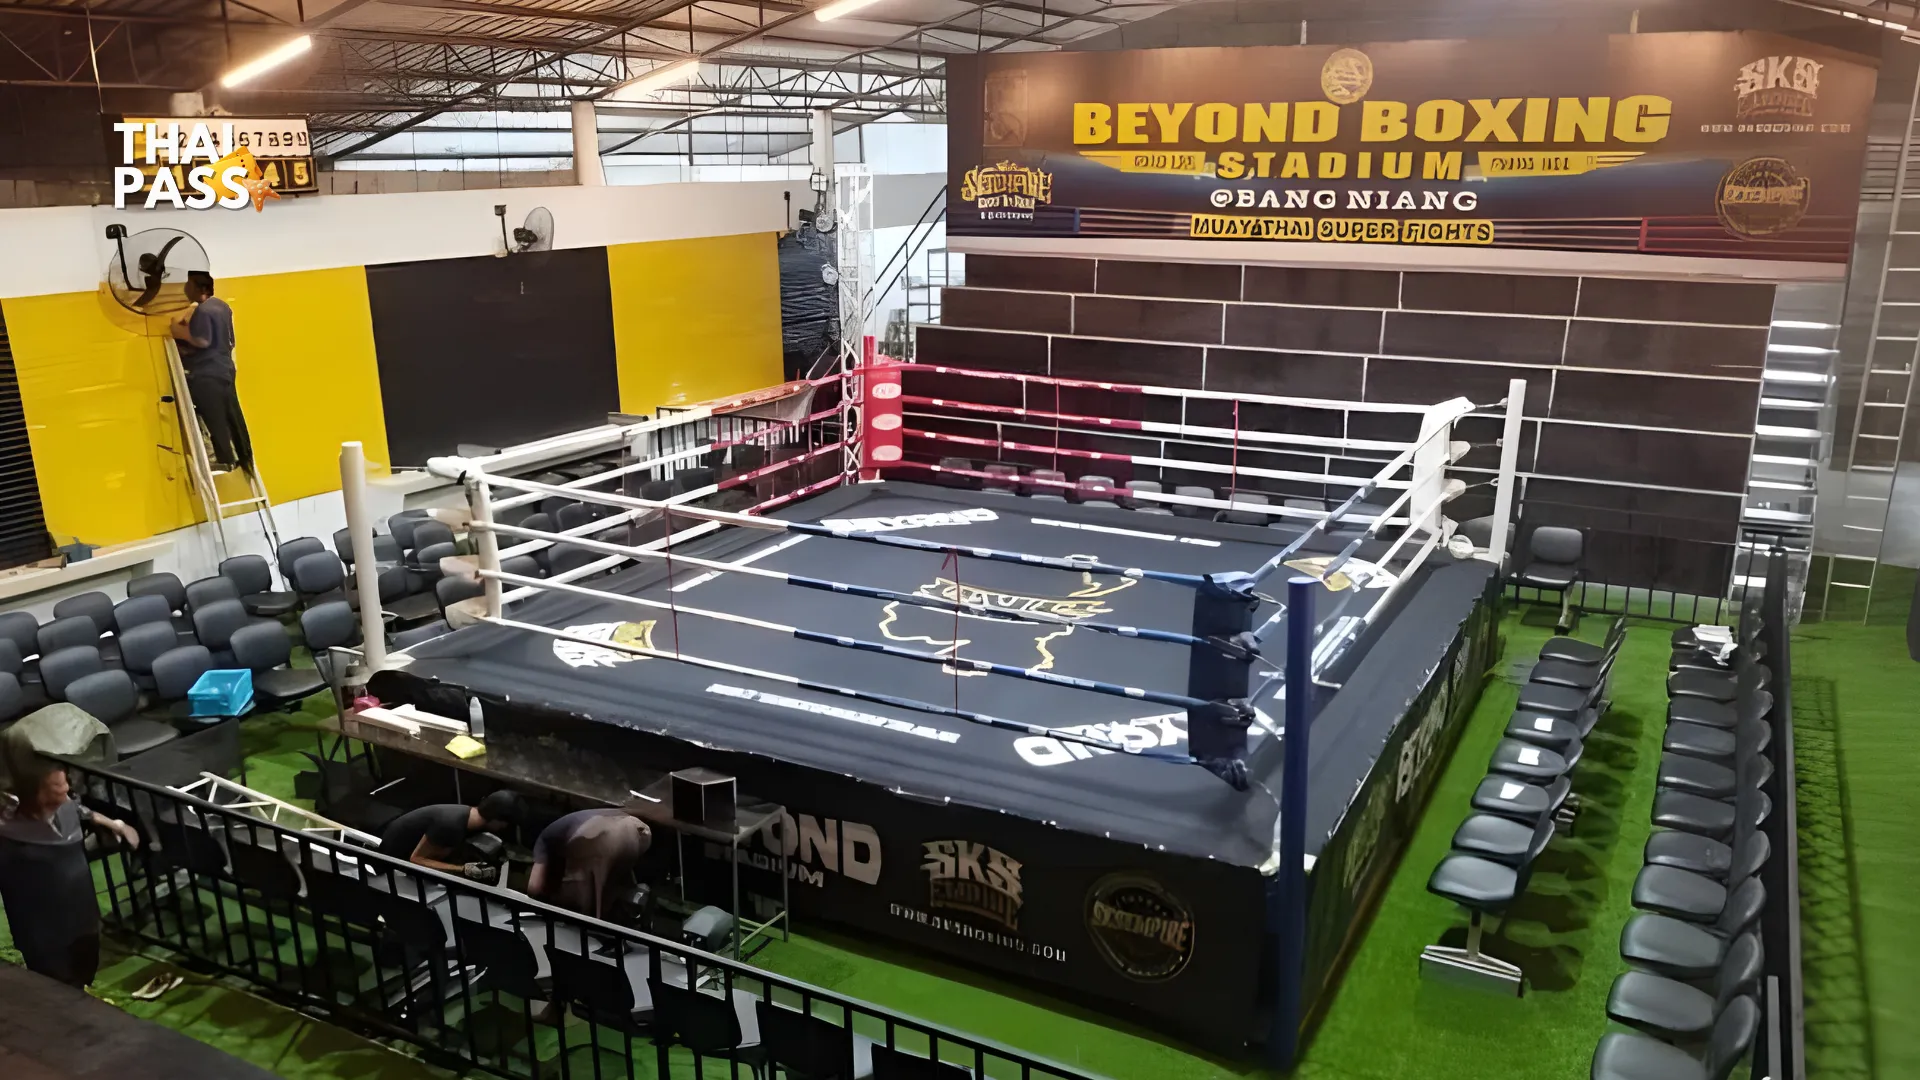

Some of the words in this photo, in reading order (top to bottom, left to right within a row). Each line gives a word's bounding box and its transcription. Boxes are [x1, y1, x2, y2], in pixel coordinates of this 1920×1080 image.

[1074, 101, 1340, 144] BEYOND
[1360, 94, 1672, 143] BOXING
[1217, 151, 1463, 180] STADIUM
[1347, 190, 1477, 212] NIANG
